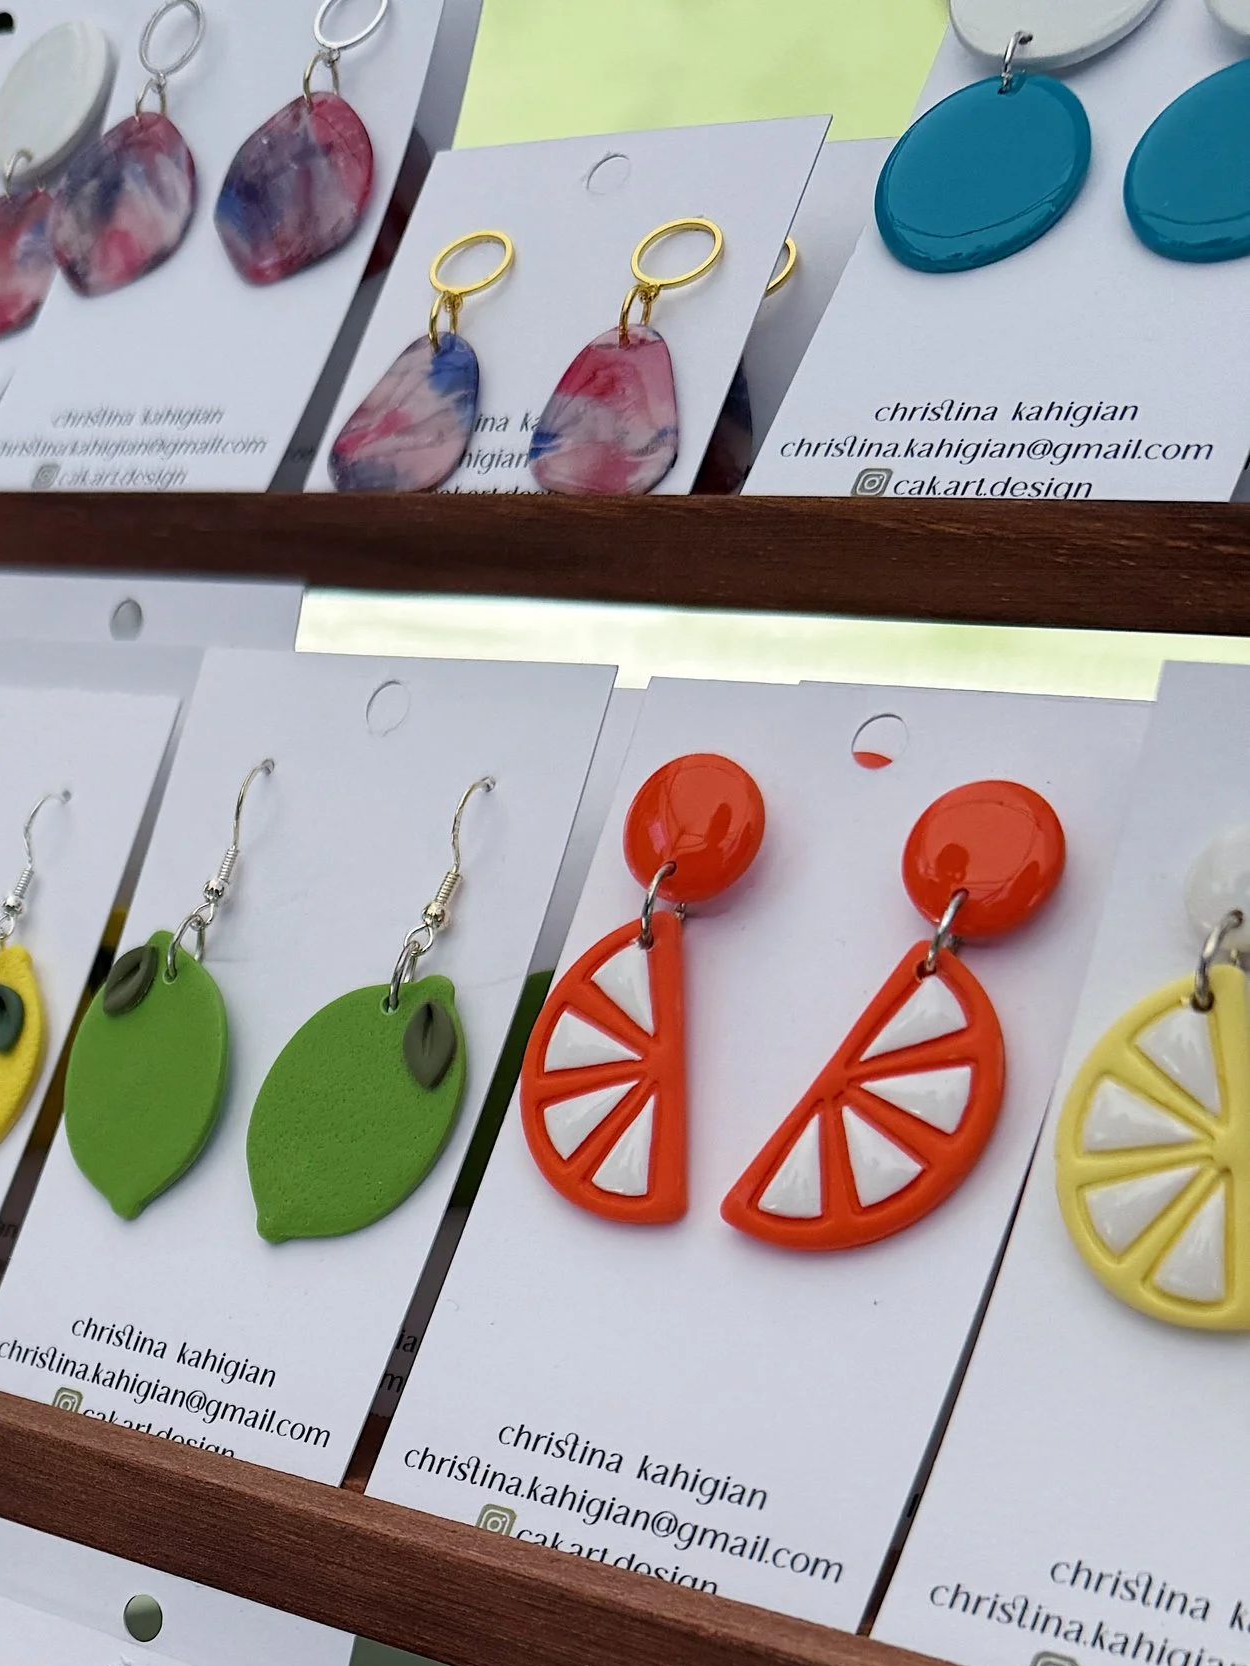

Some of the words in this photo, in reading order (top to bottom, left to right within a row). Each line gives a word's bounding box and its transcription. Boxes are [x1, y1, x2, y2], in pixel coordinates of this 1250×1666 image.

[874, 399, 998, 422] christina
[1011, 400, 1139, 428] kahigian
[780, 434, 1214, 466] christina.kahigian@gmail.com
[70, 1316, 168, 1359] christina
[176, 1341, 277, 1388] kahigian
[498, 1424, 624, 1474] christina
[636, 1455, 769, 1511] kahigian
[403, 1446, 844, 1584] christina.kahigian@gmail.com
[1050, 1559, 1211, 1622] christina
